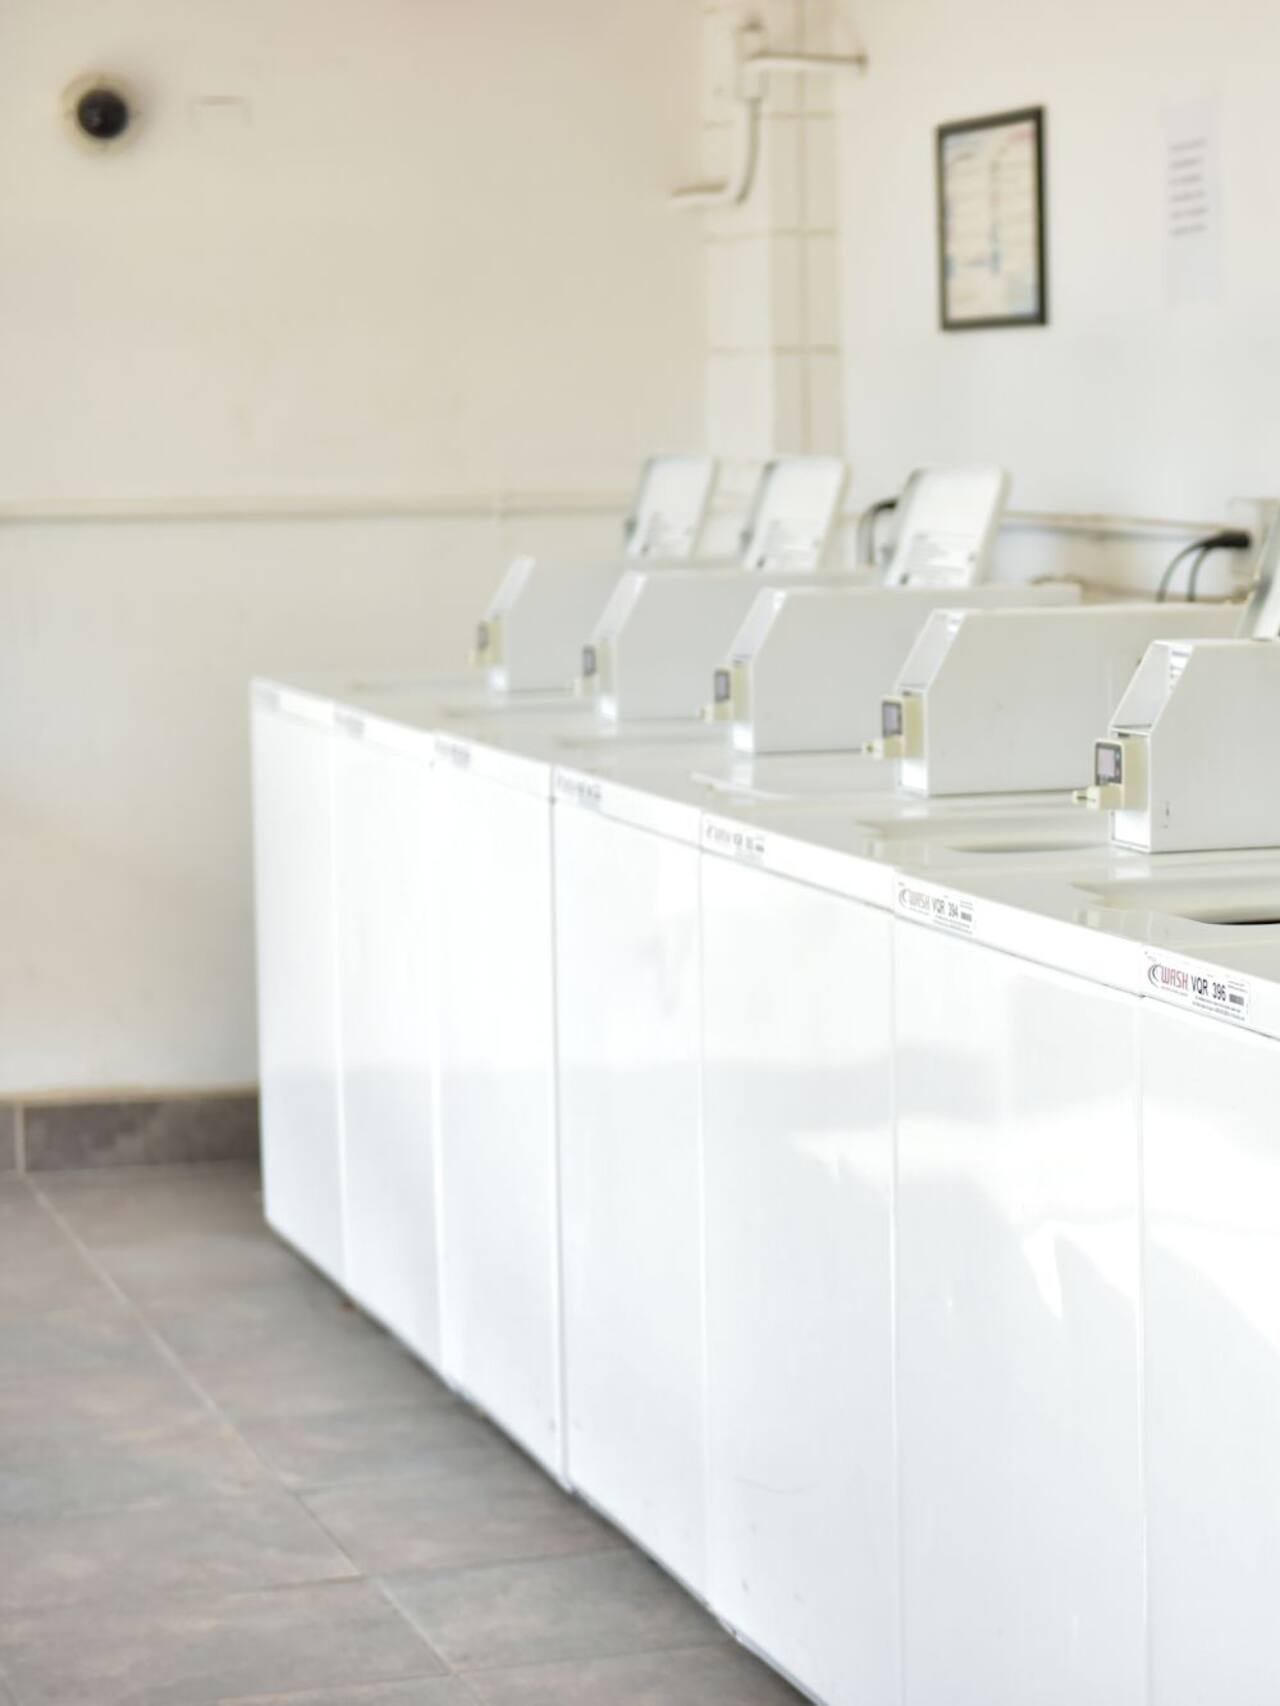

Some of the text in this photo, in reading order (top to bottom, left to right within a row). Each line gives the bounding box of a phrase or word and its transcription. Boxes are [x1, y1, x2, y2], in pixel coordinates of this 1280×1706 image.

[1161, 966, 1227, 1002] WASH VQR 396
